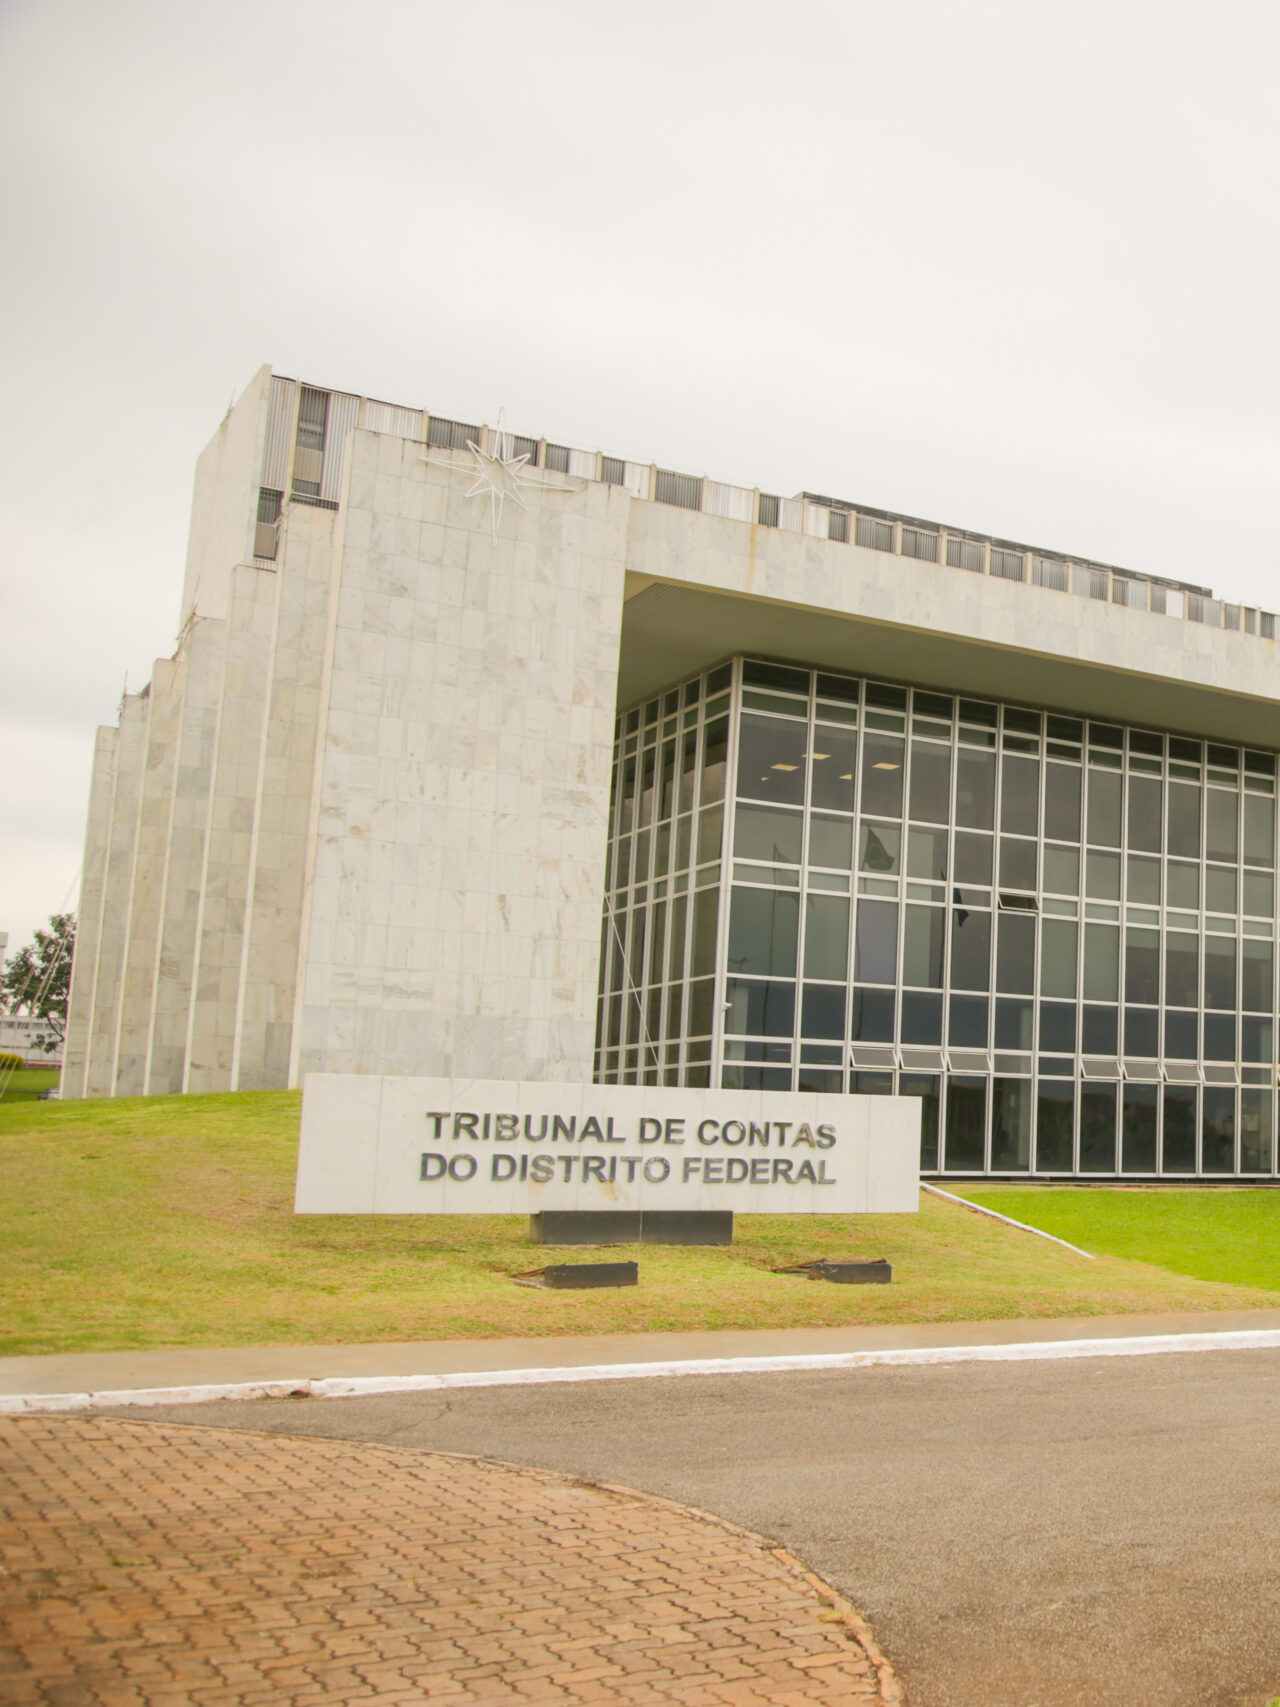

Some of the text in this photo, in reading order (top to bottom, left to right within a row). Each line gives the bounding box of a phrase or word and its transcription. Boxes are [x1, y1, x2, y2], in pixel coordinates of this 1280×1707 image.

[426, 1111, 837, 1149] TRIBUNAL DE CONTAS
[420, 1152, 837, 1185] DO DISTRITO FEDERAL
